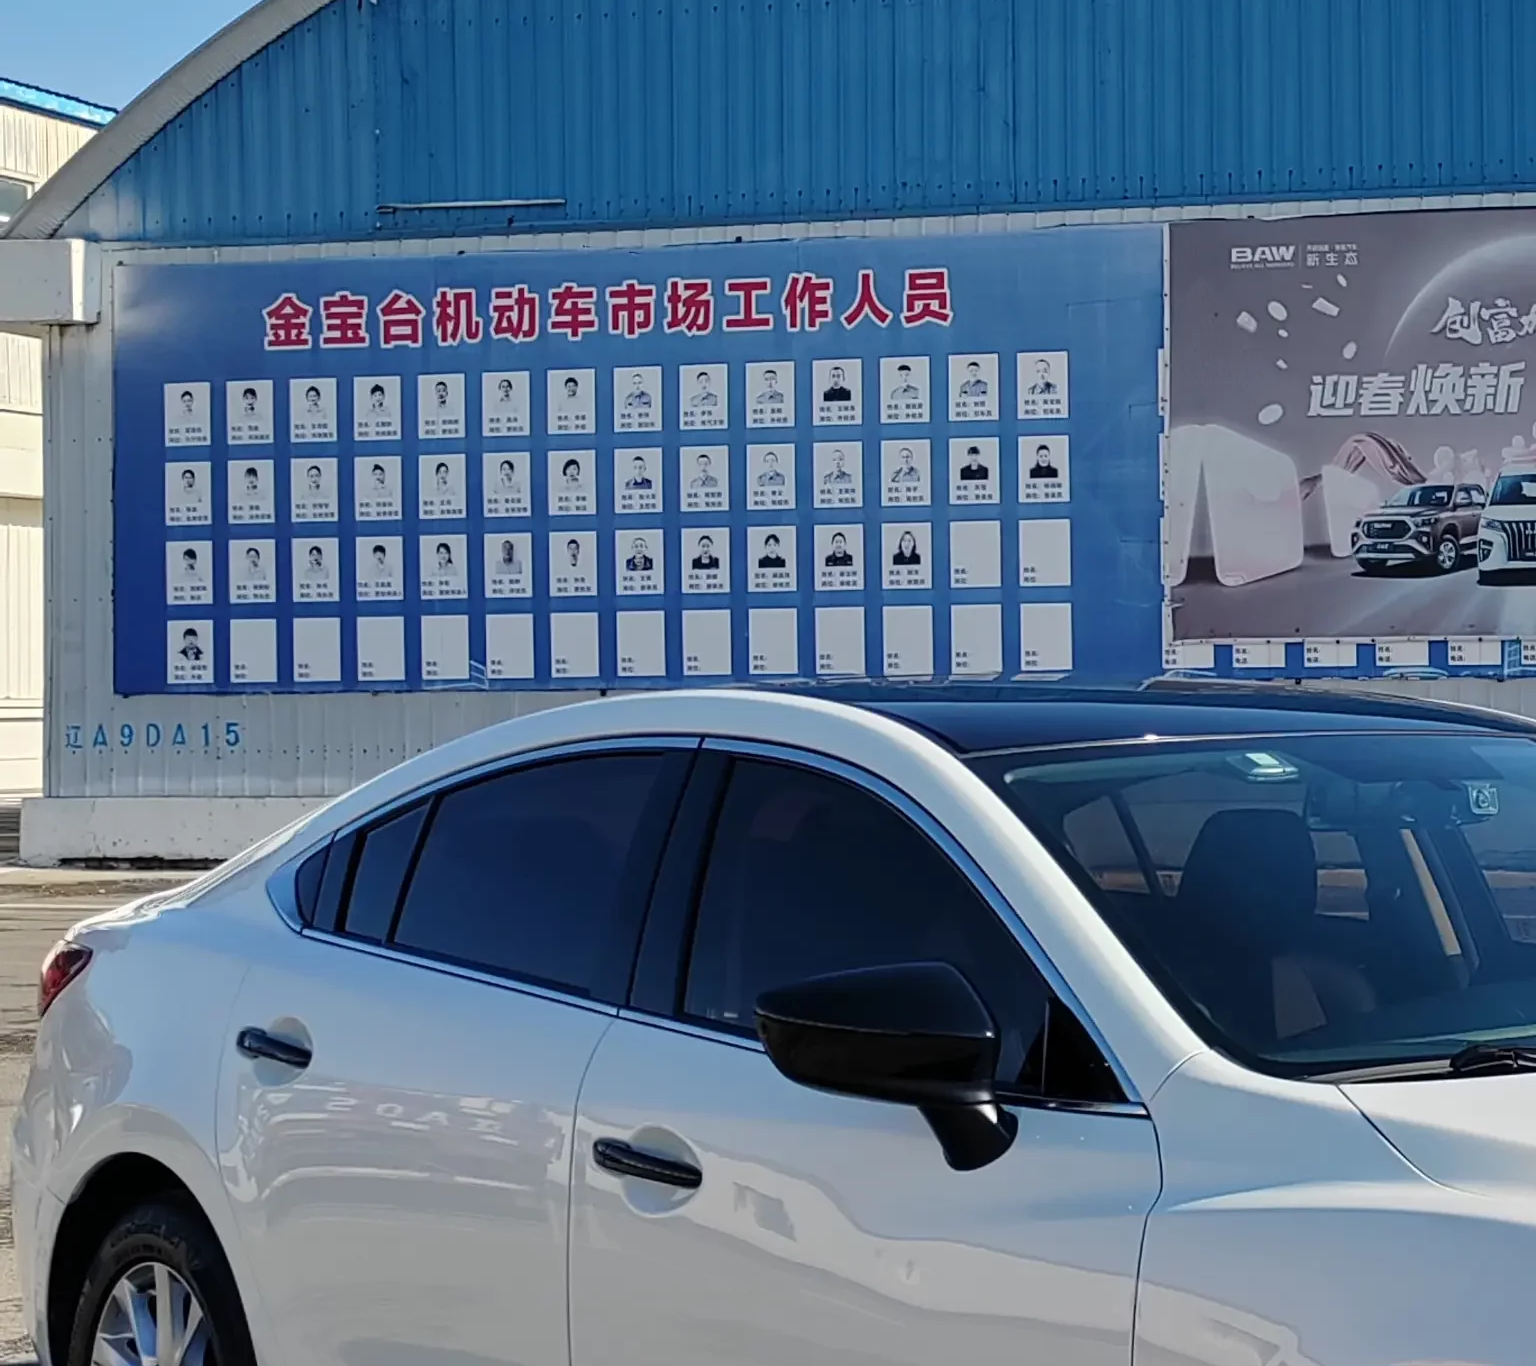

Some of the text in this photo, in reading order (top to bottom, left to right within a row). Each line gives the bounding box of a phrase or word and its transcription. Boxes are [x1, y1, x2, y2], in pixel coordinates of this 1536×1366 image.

[1231, 245, 1296, 262] BAW
[262, 267, 954, 350] 金宝台机动车市场工作人员
[1306, 361, 1527, 417] 迎春焕新
